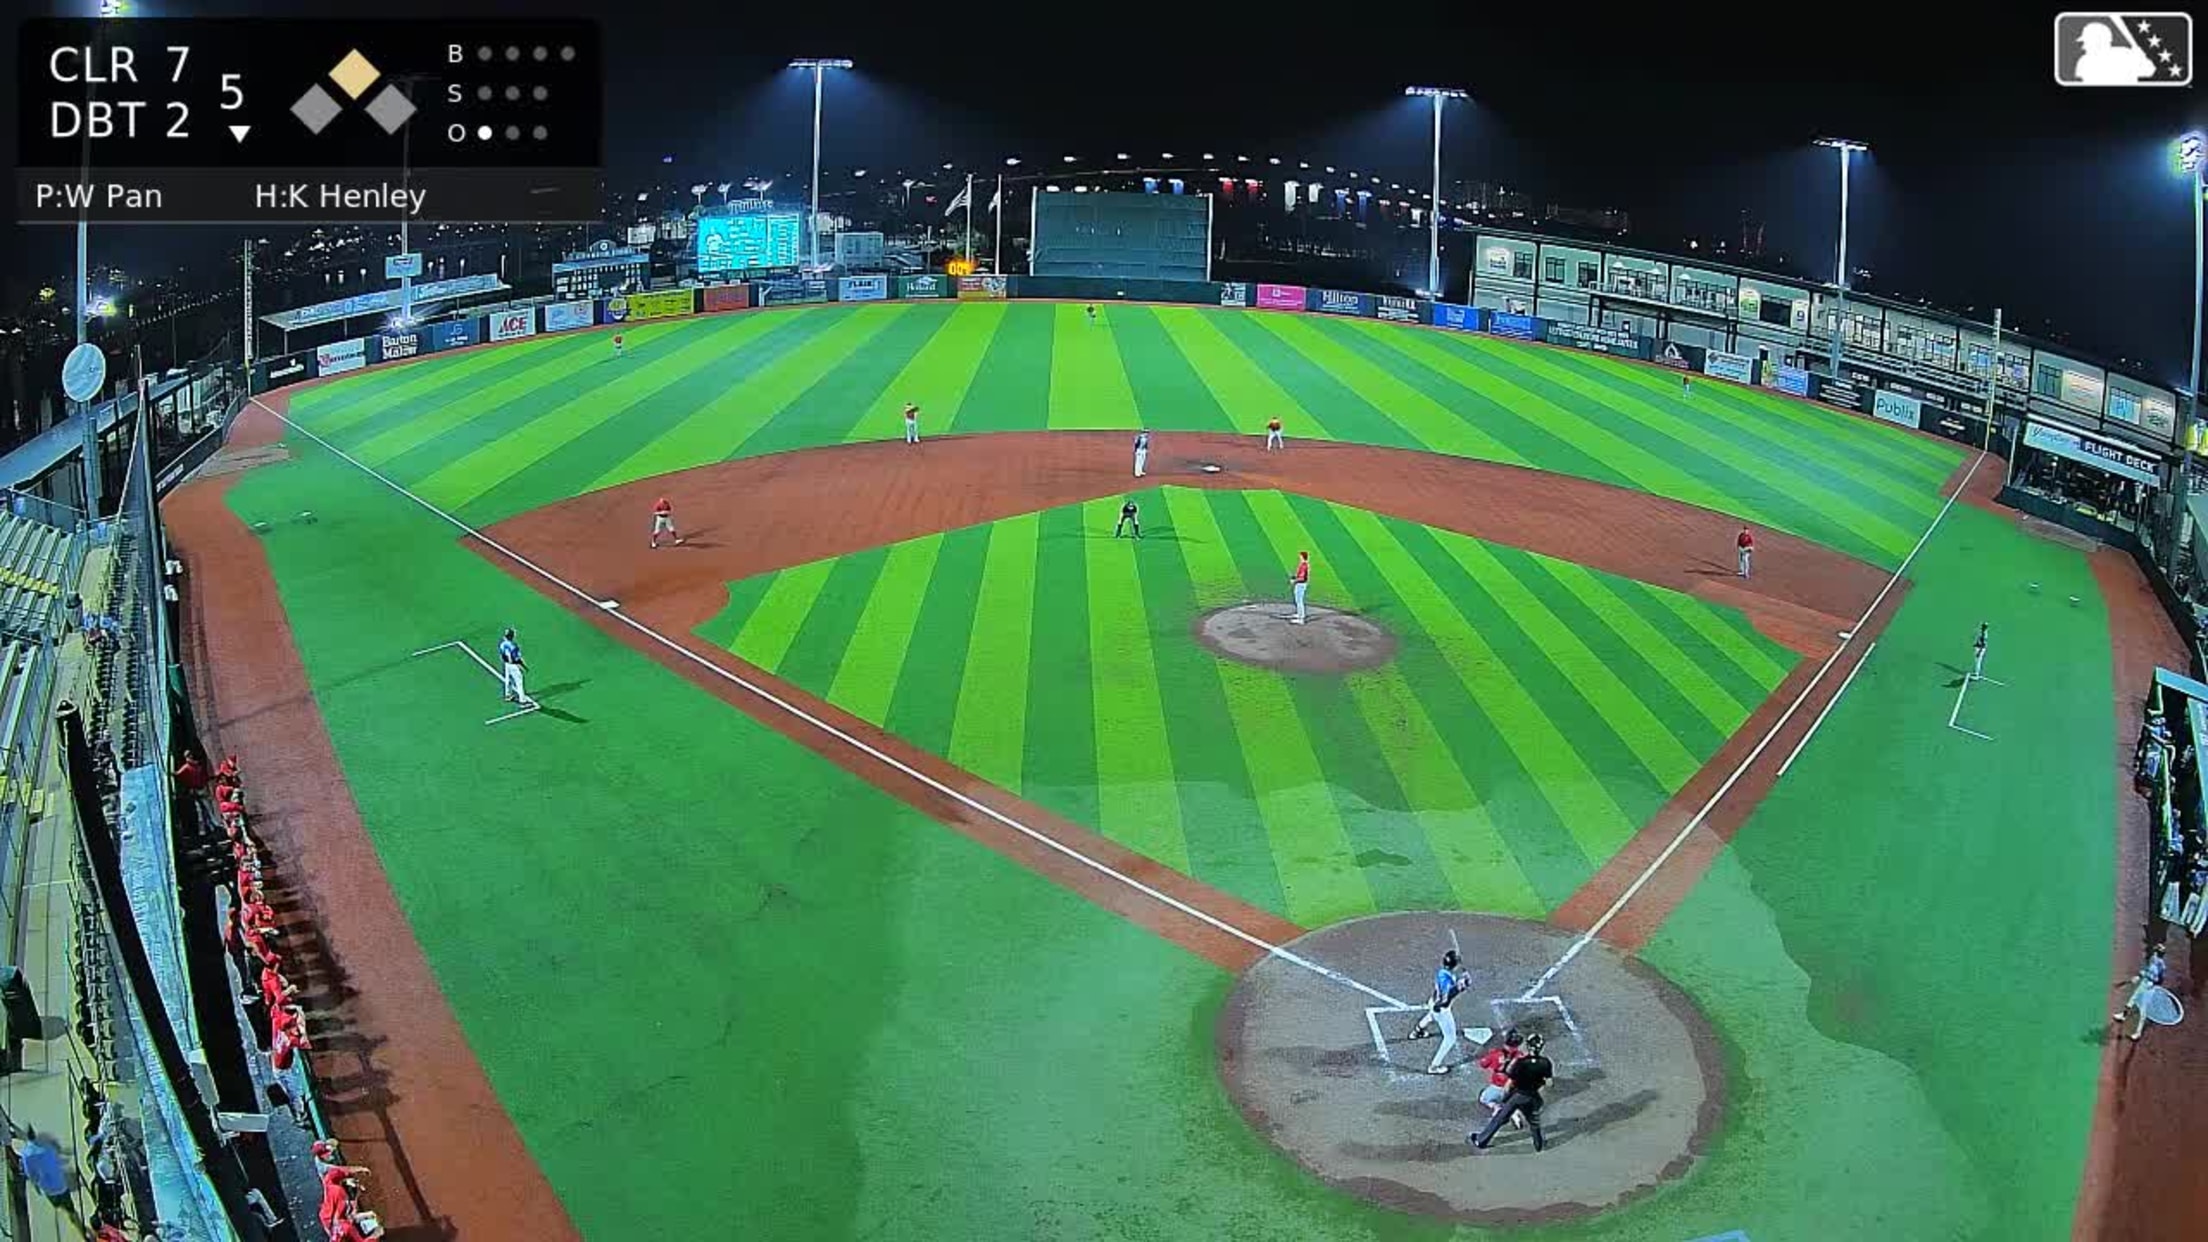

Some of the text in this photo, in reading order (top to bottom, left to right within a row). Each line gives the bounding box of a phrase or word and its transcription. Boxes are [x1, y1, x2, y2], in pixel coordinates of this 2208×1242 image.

[1322, 290, 1358, 305] Hilton
[499, 316, 527, 333] ACE
[1876, 397, 1915, 421] Publix
[2084, 440, 2156, 473] FLIGHT DECK
